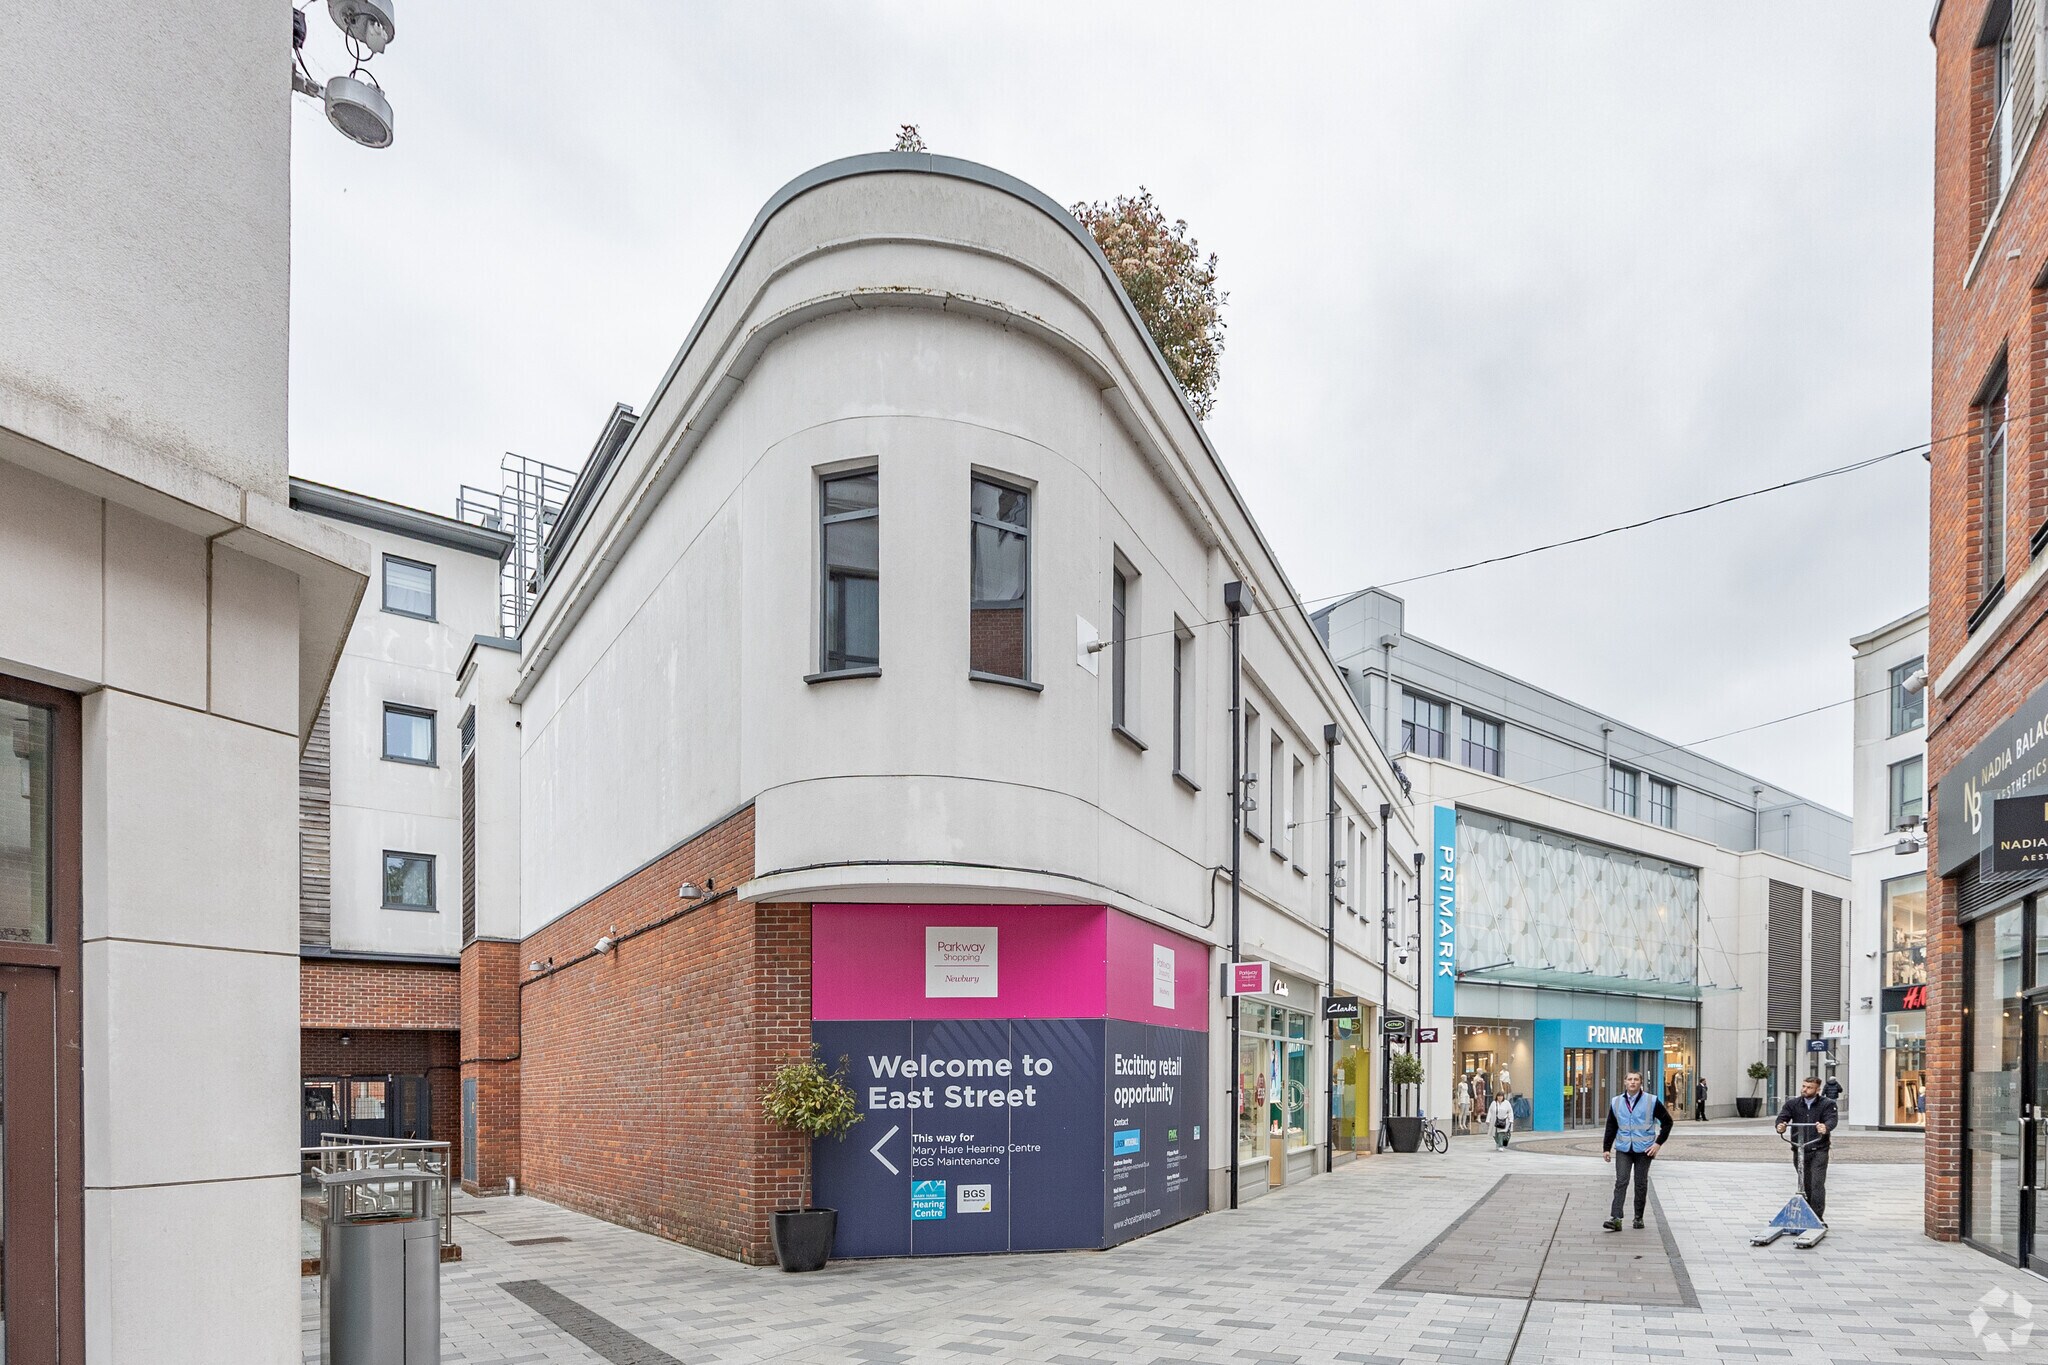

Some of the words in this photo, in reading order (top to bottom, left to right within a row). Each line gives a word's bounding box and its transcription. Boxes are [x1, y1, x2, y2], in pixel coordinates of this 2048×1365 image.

[1981, 747, 2013, 787] NADIA
[2000, 837, 2048, 851] NADIA
[1439, 845, 1454, 977] PRIMARK
[937, 941, 986, 954] Parkway
[943, 953, 981, 963] Shopping
[944, 974, 980, 984] Newbury
[1327, 1003, 1357, 1013] Clarks
[1588, 1025, 1643, 1045] PRIMARK
[868, 1054, 1013, 1079] Welcome
[1021, 1054, 1053, 1077] to
[1114, 1053, 1157, 1080] Exciting
[1159, 1056, 1182, 1076] retail
[869, 1086, 934, 1110] East
[944, 1085, 1037, 1108] Street
[1114, 1081, 1174, 1109] opportunity
[1113, 1118, 1129, 1127] Contact
[912, 1134, 933, 1143] This
[936, 1134, 957, 1144] way
[959, 1132, 975, 1142] for
[912, 1146, 937, 1156] Mary
[940, 1145, 964, 1155] Hare
[966, 1144, 1005, 1155] Hearing
[1007, 1143, 1041, 1153] Centre
[912, 1158, 934, 1167] BGS
[937, 1156, 1001, 1167] Maintenance
[963, 1189, 986, 1199] BGS
[912, 1200, 945, 1209] Hearing
[914, 1209, 943, 1218] Centre
